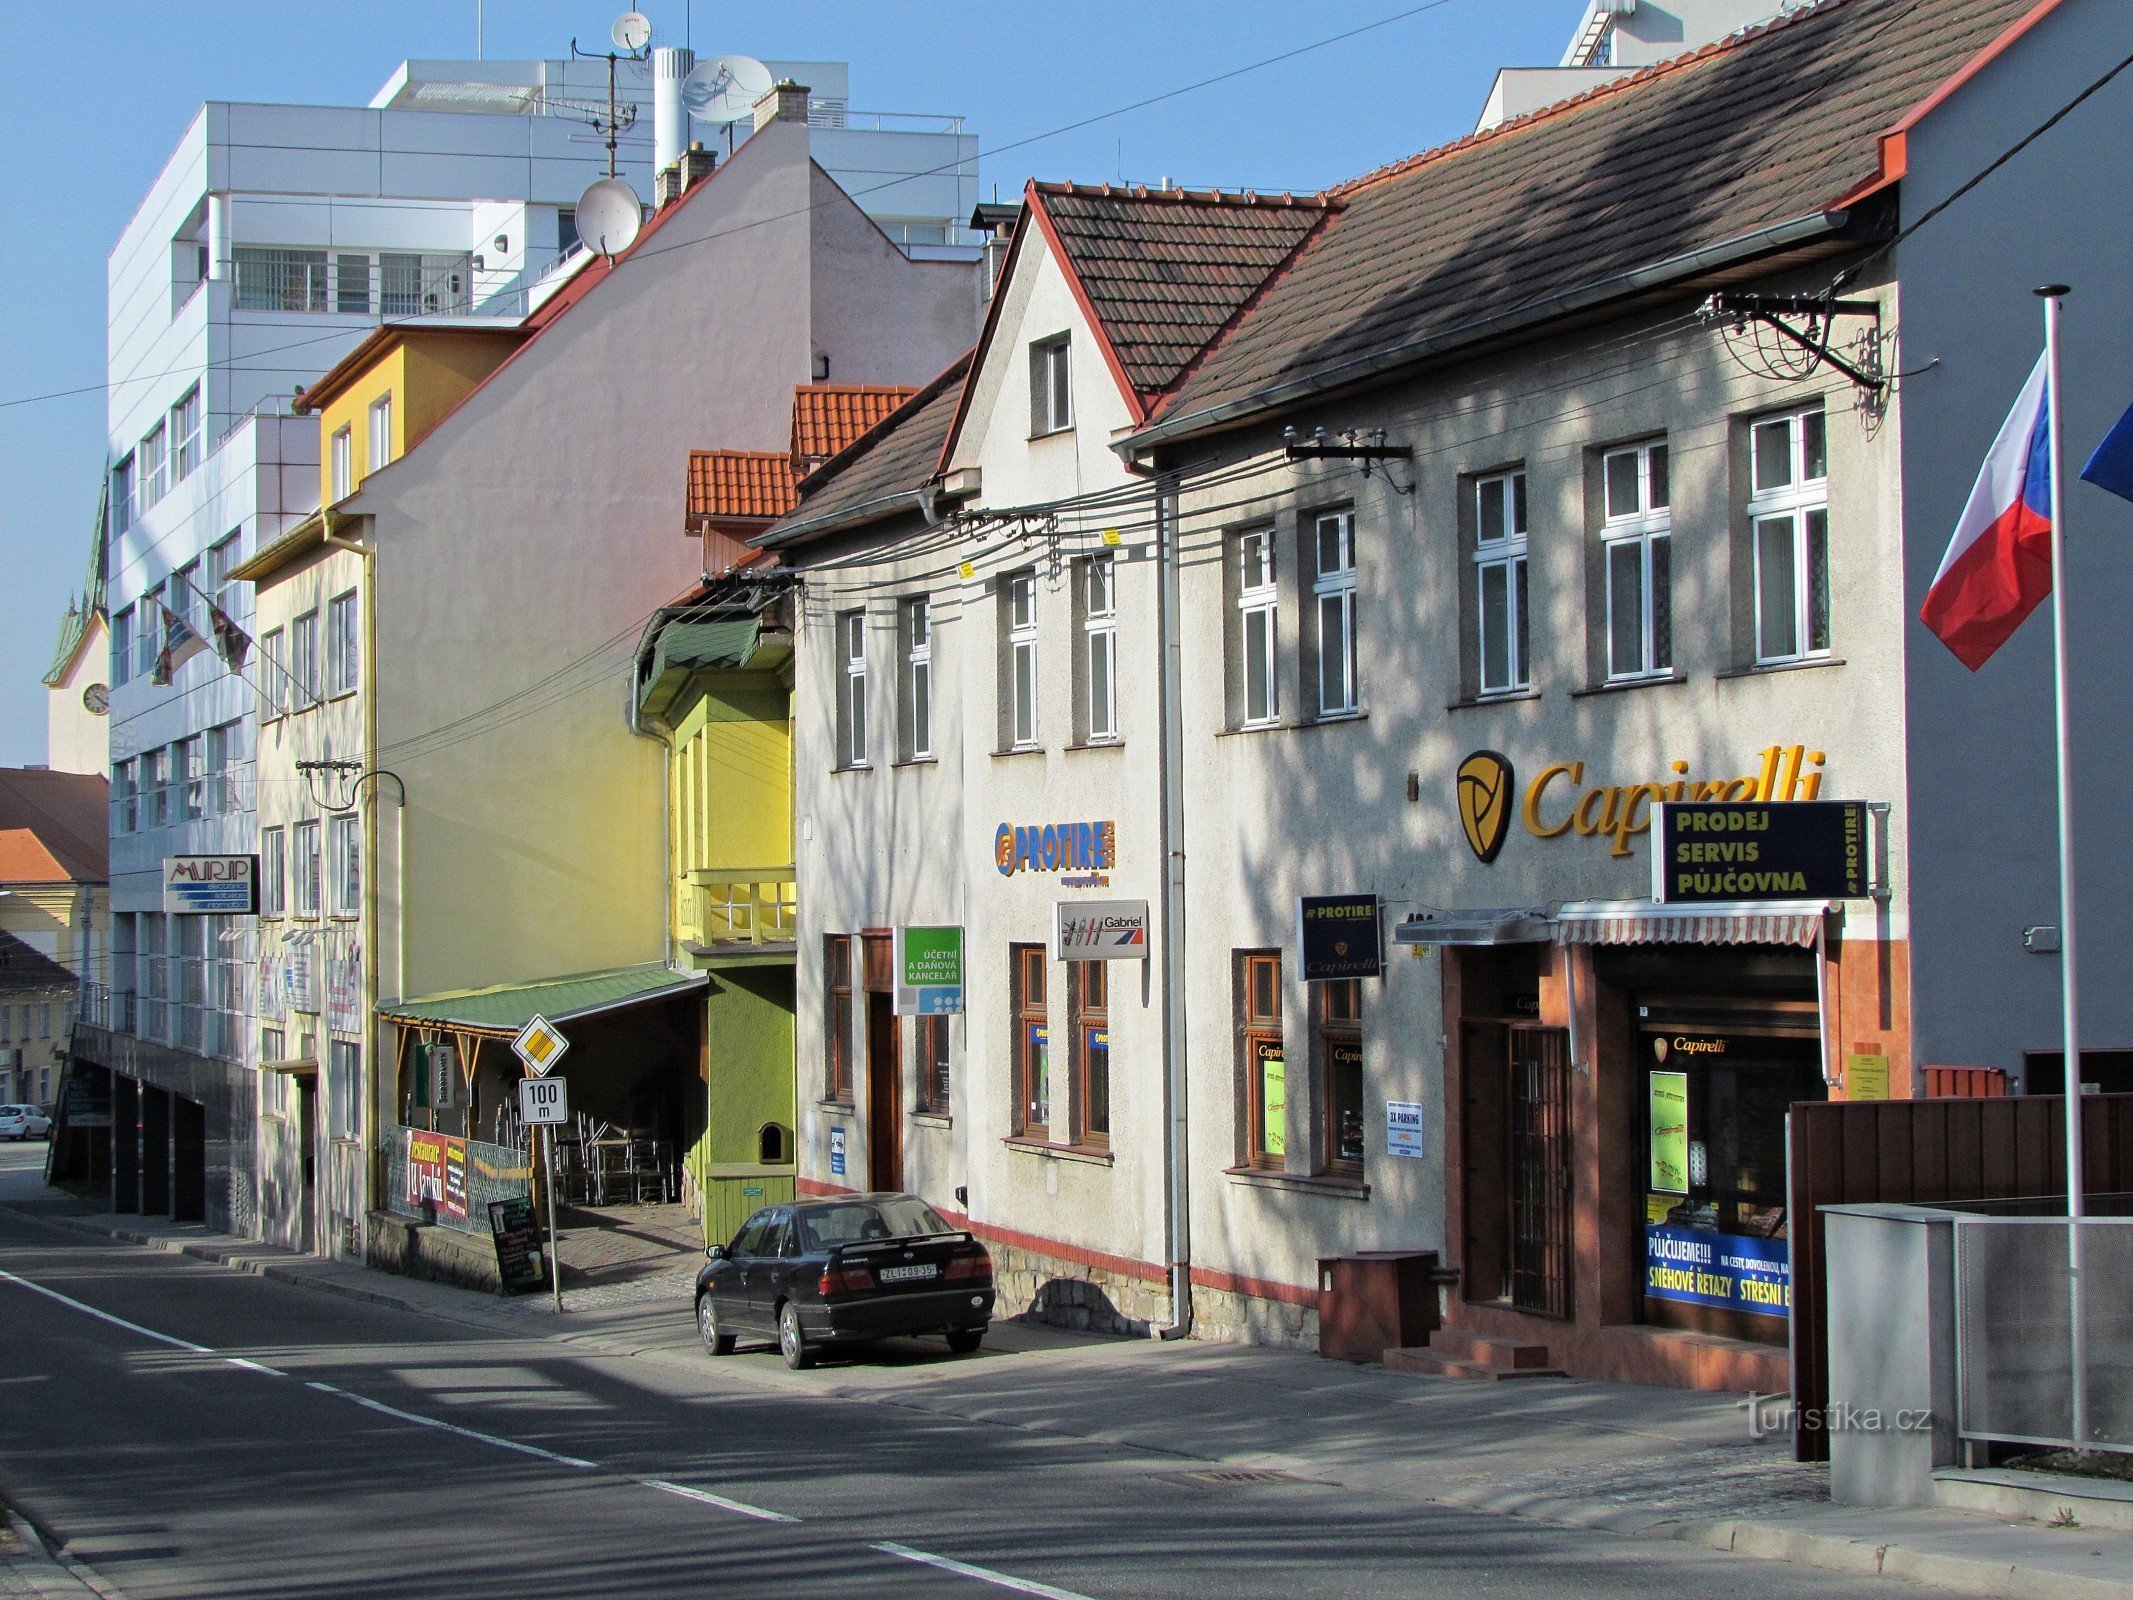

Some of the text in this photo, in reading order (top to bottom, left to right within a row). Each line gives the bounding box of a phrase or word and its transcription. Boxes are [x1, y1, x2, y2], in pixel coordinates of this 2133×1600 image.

[1676, 811, 1769, 832] PRODEJ
[1015, 821, 1109, 870] PROTIRE
[1676, 842, 1760, 863] SERVIS
[1844, 808, 1858, 878] PROTIRE
[1677, 867, 1808, 893] PŮJČOVNA
[1318, 905, 1372, 918] PROTIRE
[1104, 916, 1143, 928] Gabriel
[923, 949, 957, 959] ÚČETNÍ
[908, 960, 957, 970] A DAŇOVÁ
[1306, 957, 1378, 974] Capirelli
[908, 971, 957, 980] KANCELÁŘ
[1673, 1037, 1725, 1055] Capirelli
[528, 1084, 557, 1104] 100
[539, 1106, 550, 1118] m
[1397, 1112, 1420, 1125] PARKING
[410, 1138, 440, 1163] restaurace
[410, 1162, 418, 1196] U
[1648, 1231, 1711, 1264] PŮJČUJEME!!!
[1649, 1262, 1695, 1292] SNĚHOVÉ
[1696, 1267, 1732, 1298] ŘETAZY
[1740, 1273, 1782, 1306] STŘEŠNÍ
